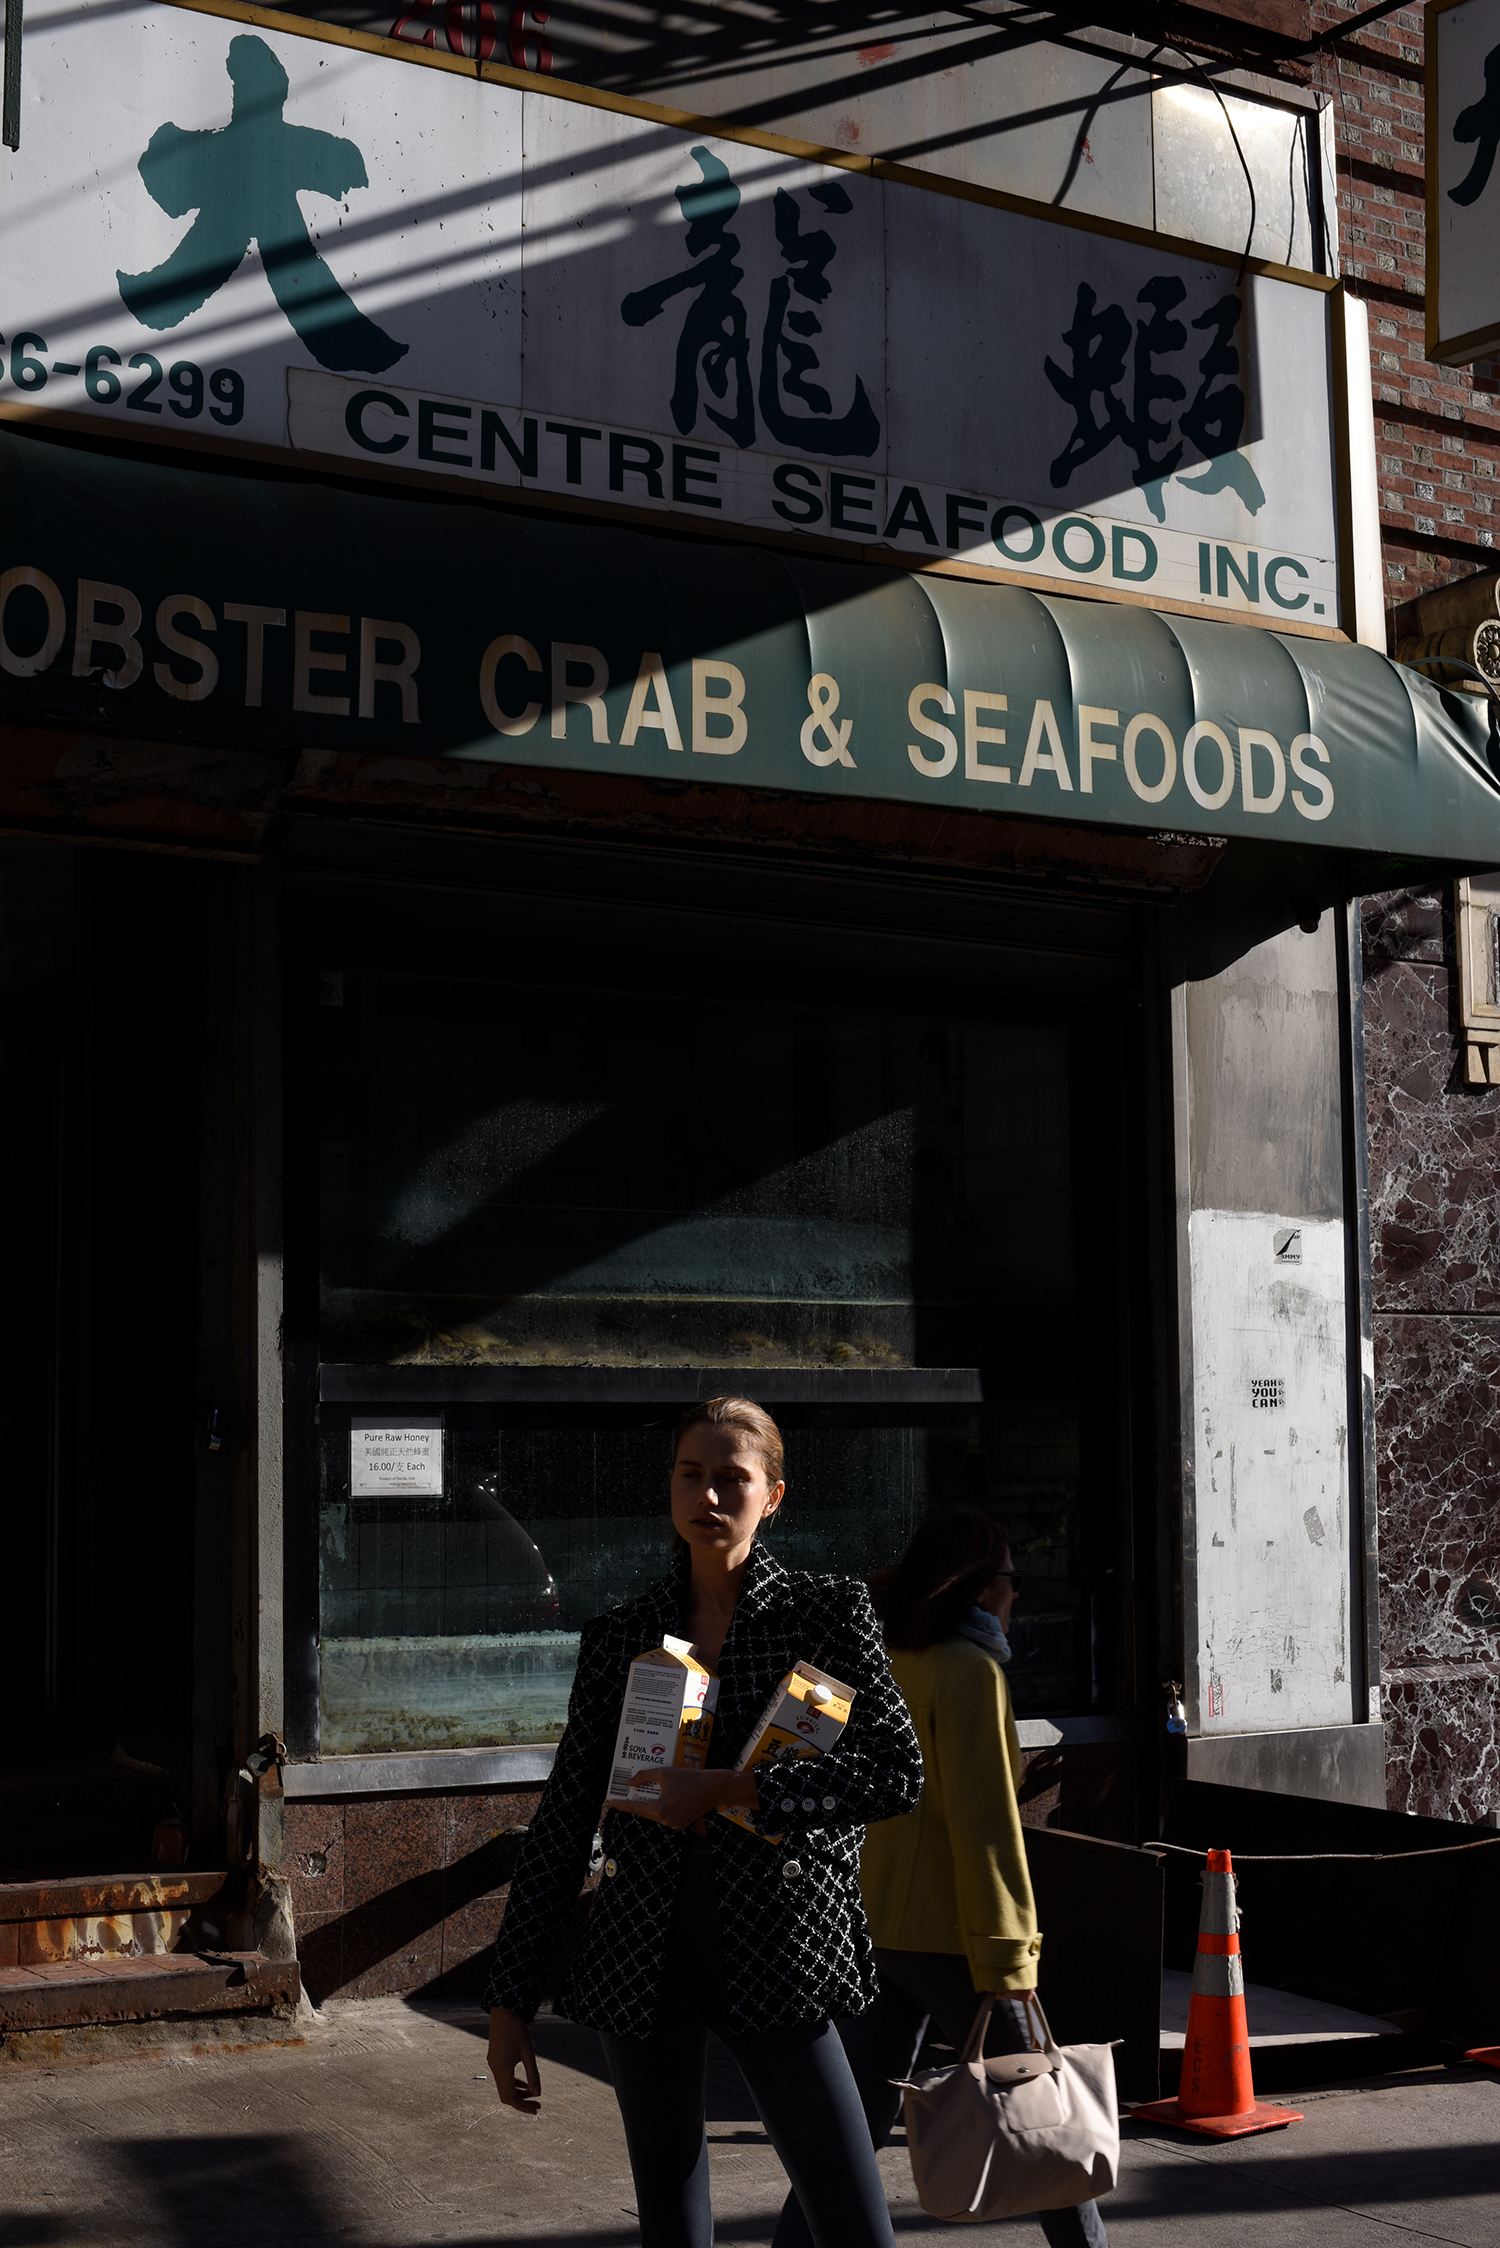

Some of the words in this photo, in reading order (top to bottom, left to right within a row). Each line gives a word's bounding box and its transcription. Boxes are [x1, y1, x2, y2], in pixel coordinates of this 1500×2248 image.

[389, 0, 553, 75] 206
[116, 34, 1266, 523] 大龍蝦
[0, 331, 245, 427] 6-6299
[345, 389, 722, 510] CENTRE
[772, 463, 1158, 583] SEAFOOD
[1199, 541, 1325, 615] INC.
[479, 634, 748, 755] CRAB
[800, 672, 858, 769] &
[907, 682, 1335, 821] SEAFOODS
[1251, 1379, 1277, 1387] YEAH
[1251, 1387, 1277, 1398] YOU
[1252, 1398, 1278, 1408] CAN
[364, 1433, 383, 1442] Pure
[385, 1433, 402, 1442] Raw
[404, 1433, 430, 1443] Honey
[406, 1462, 426, 1471] Each
[796, 1716, 821, 1732] SUNRISE
[629, 1744, 647, 1754] SOYA
[627, 1751, 665, 1765] BEVERAGE
